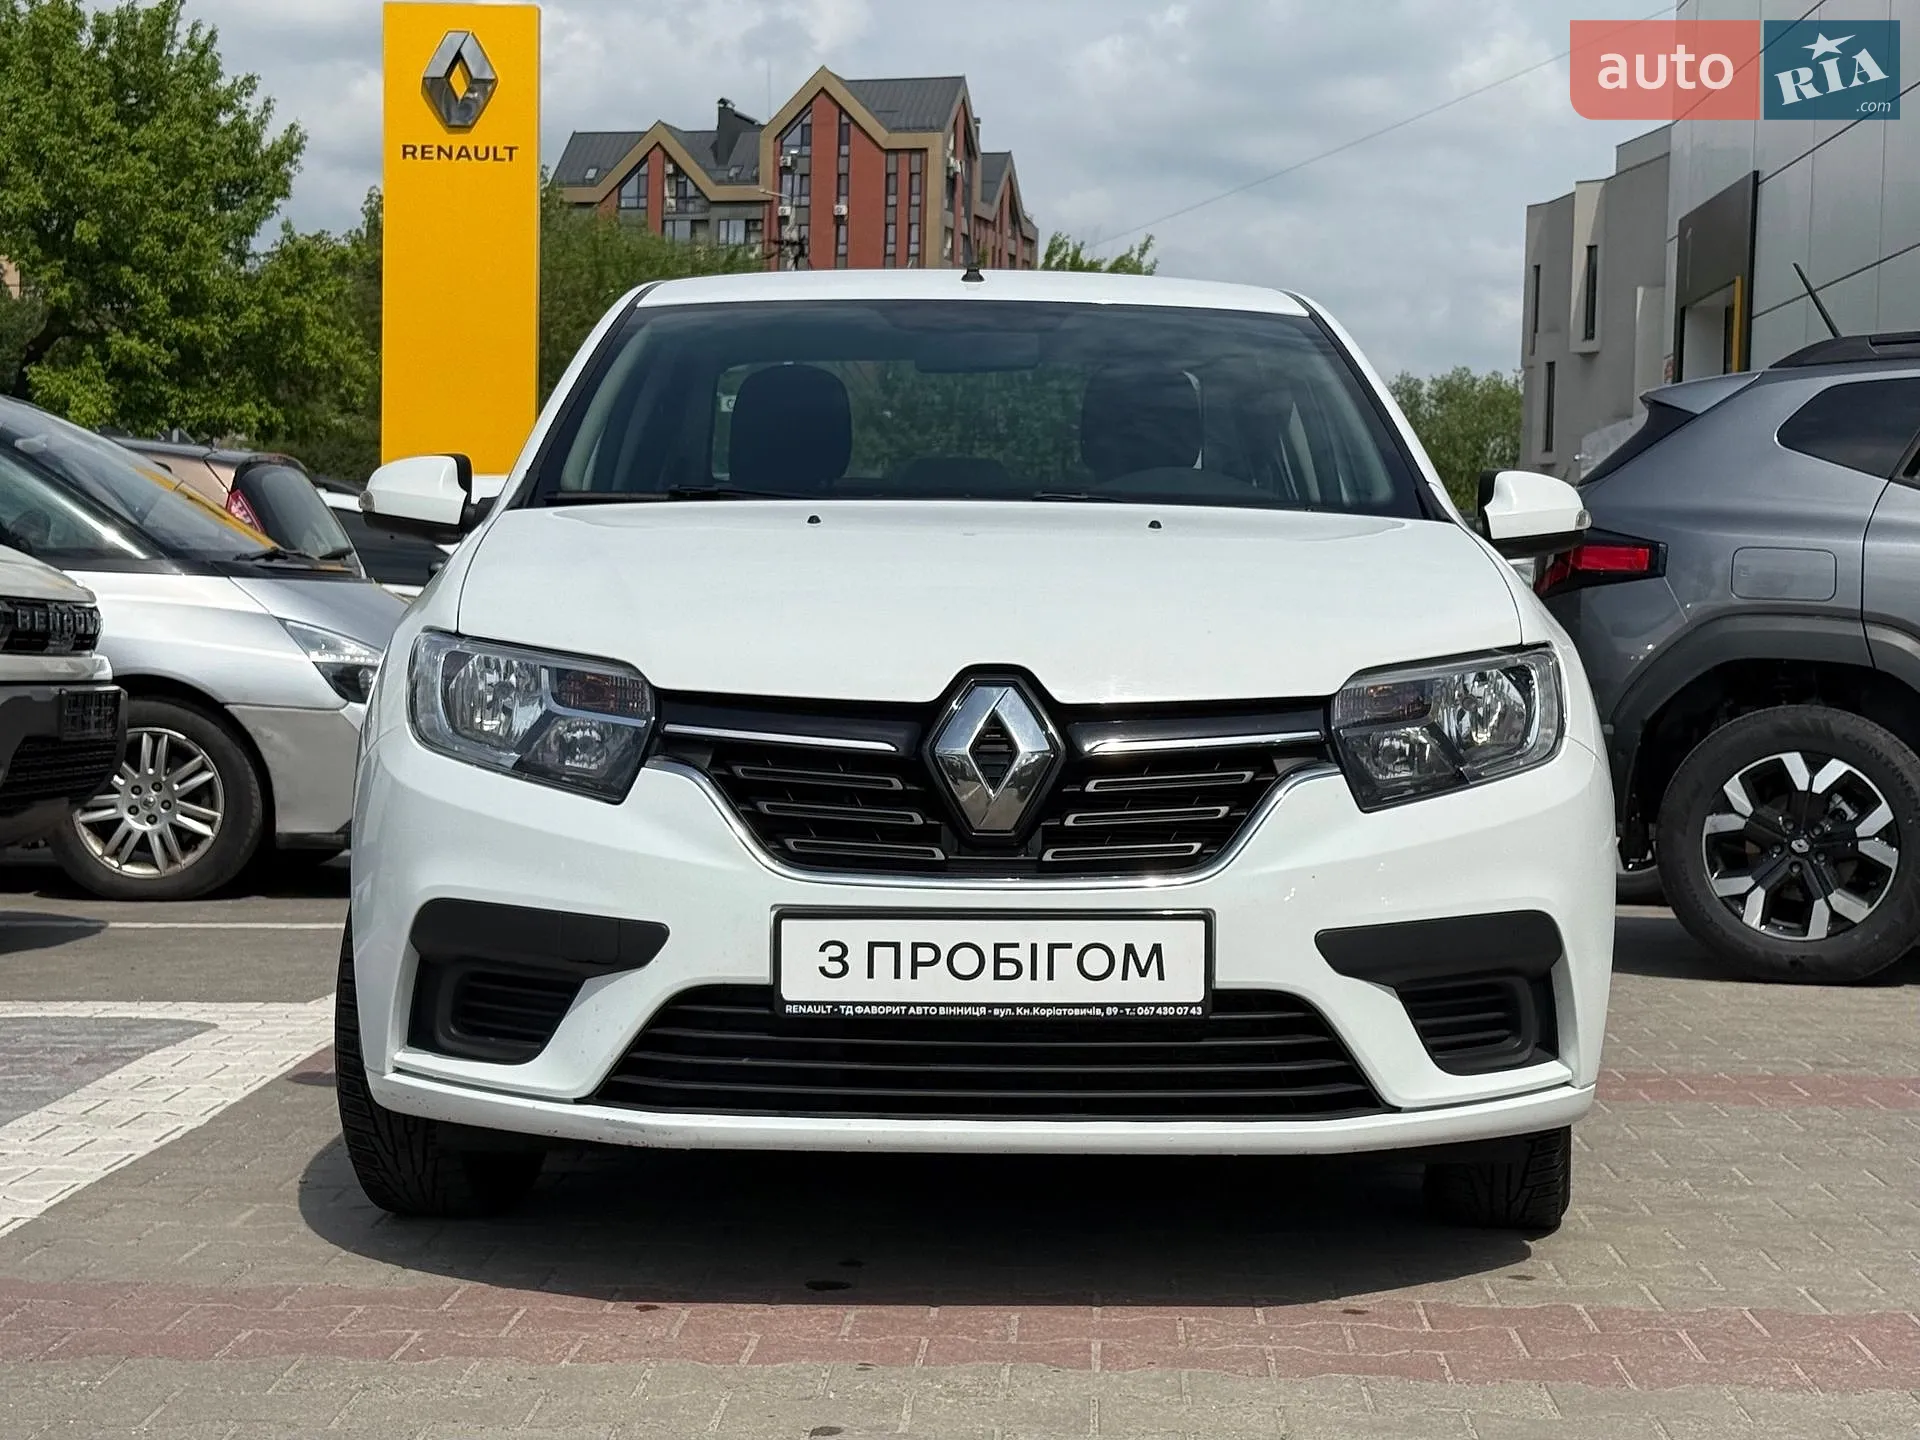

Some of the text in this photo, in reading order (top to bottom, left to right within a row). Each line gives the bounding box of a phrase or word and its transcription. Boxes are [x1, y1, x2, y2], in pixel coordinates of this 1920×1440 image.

[401, 143, 520, 163] RENAULT
[866, 940, 1166, 982] ПРОБІГОМ
[785, 1004, 833, 1014] RENAULT
[839, 1005, 854, 1017] ТД
[854, 1005, 907, 1016] ФАВОРИТ
[908, 1006, 938, 1016] АВТО
[939, 1006, 987, 1017] ВІННИЦЯ
[993, 1007, 1015, 1018] вул.
[1136, 1006, 1155, 1016] 067
